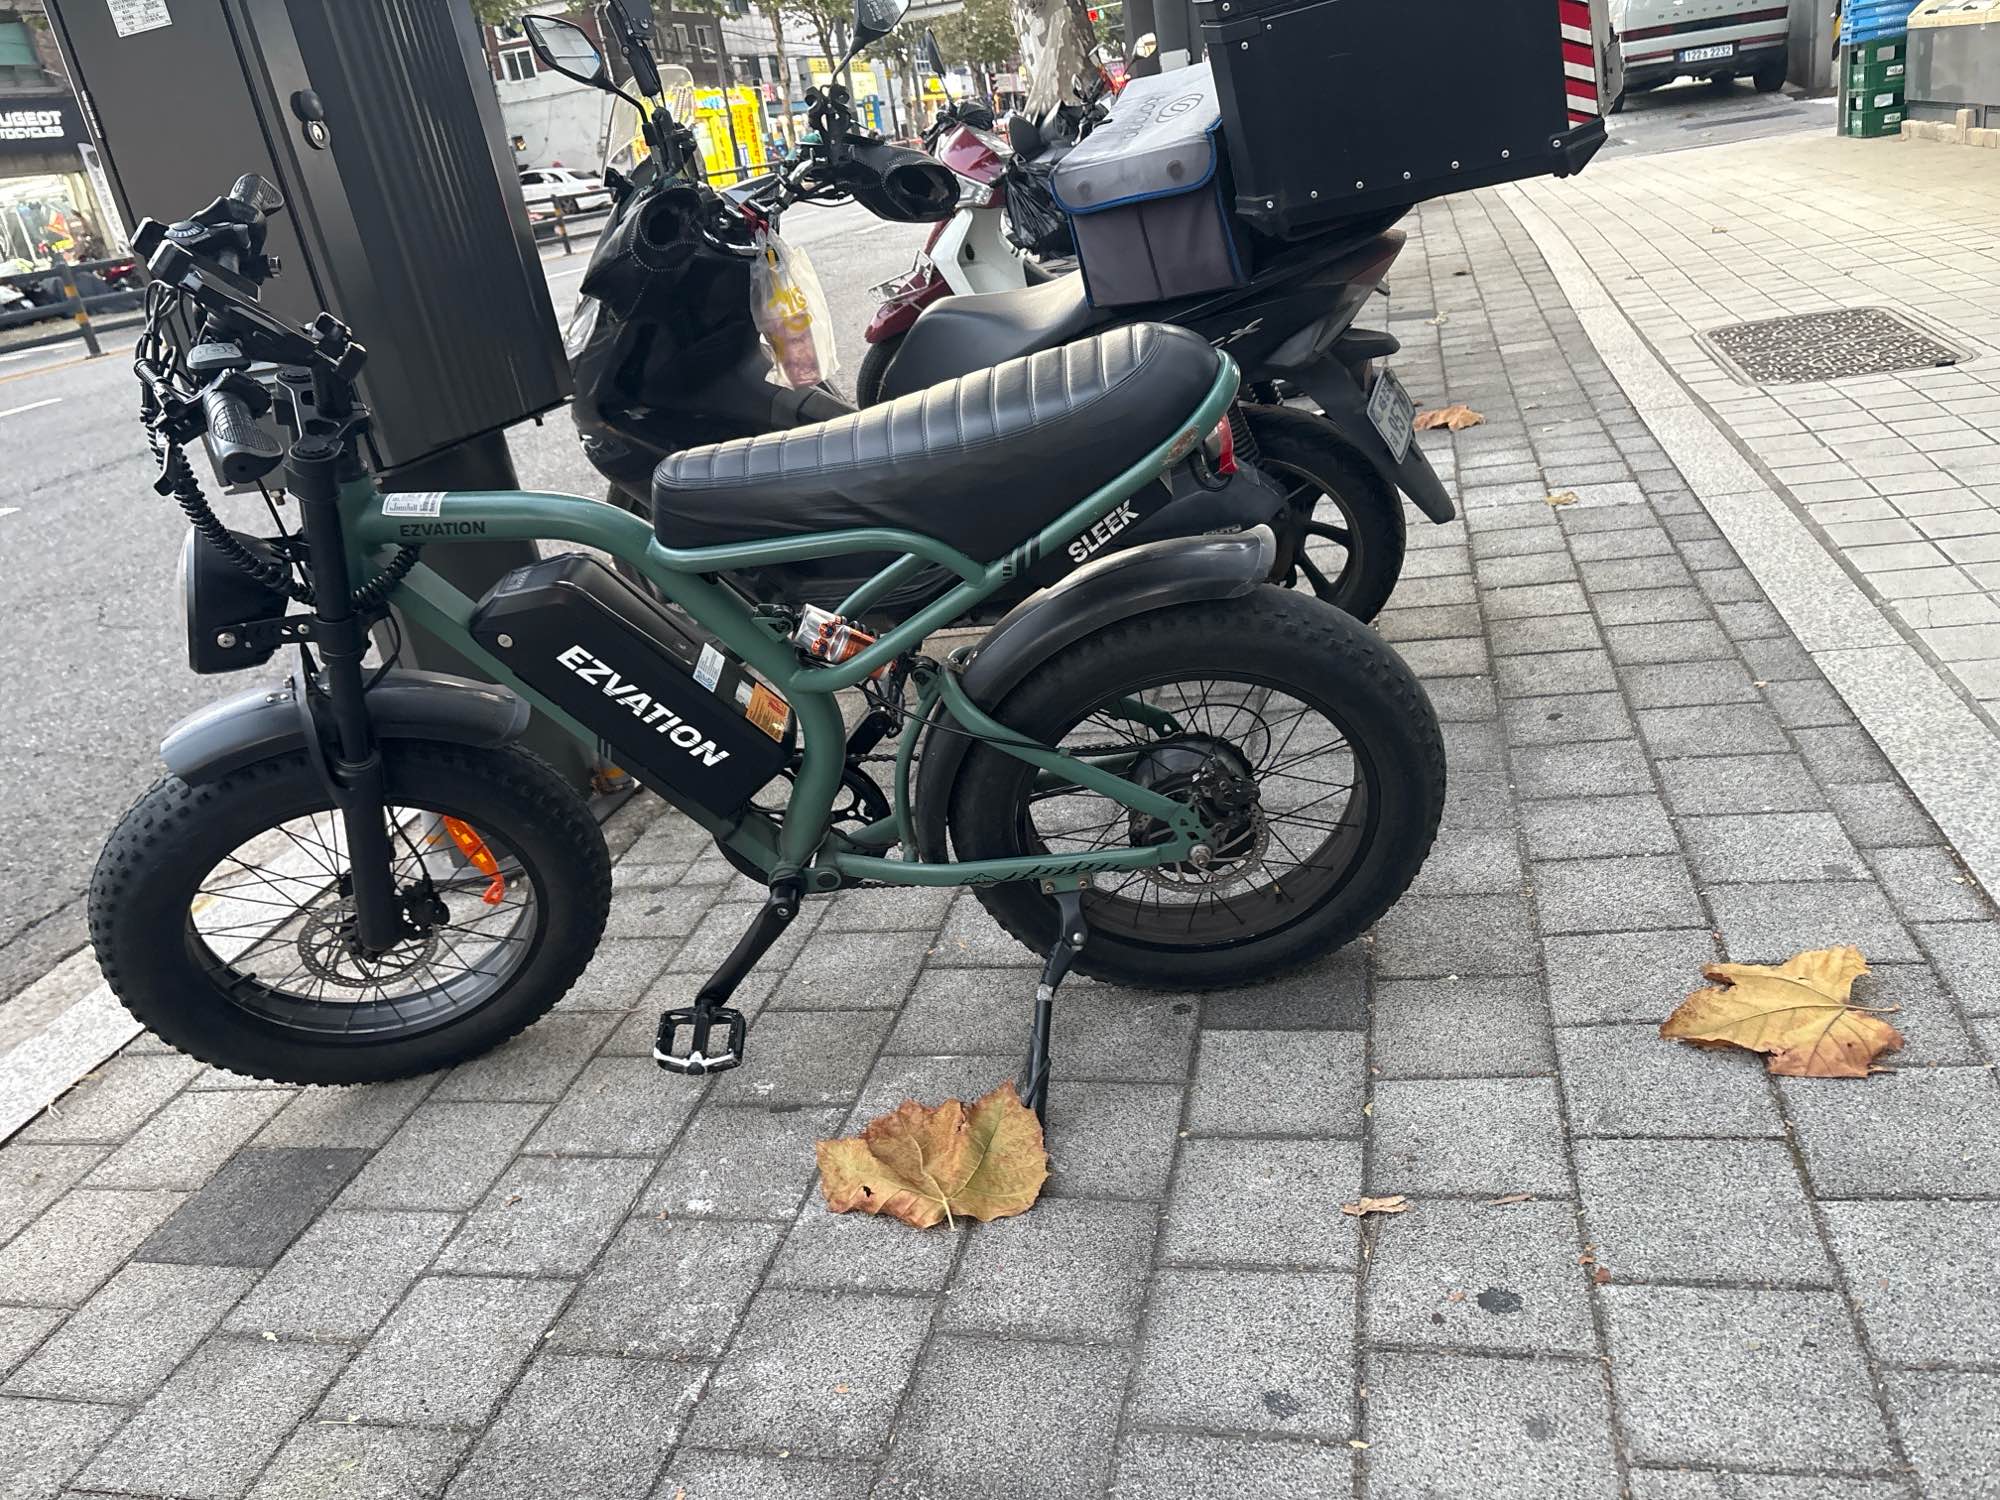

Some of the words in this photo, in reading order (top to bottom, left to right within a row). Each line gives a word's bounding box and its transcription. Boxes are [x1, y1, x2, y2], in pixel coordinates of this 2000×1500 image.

[399, 520, 487, 538] EZVATION
[1066, 499, 1140, 564] SLEEK
[555, 644, 730, 768] EZVATION
